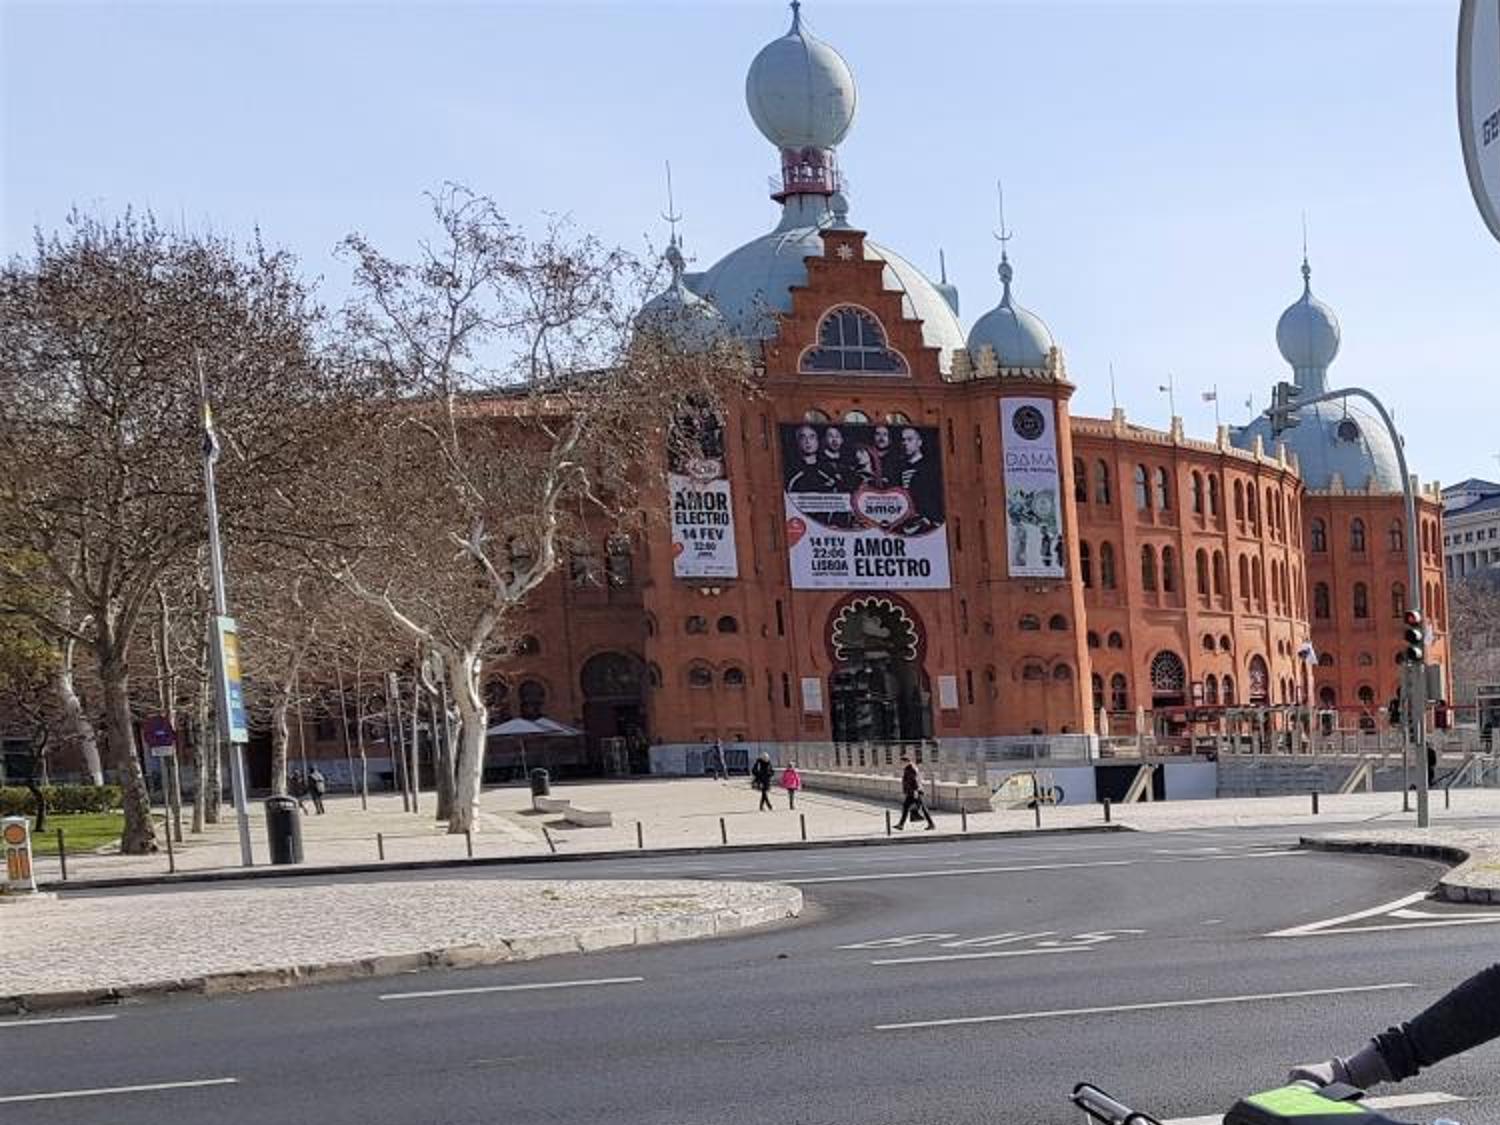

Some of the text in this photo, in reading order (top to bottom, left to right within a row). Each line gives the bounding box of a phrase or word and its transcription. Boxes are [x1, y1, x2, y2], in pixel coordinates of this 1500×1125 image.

[674, 490, 728, 511] AMOR
[865, 504, 902, 515] amor
[675, 511, 729, 526] ELECTRO
[682, 528, 724, 540] 14 FEV
[809, 536, 846, 547] 14 FEV
[853, 538, 906, 557] AMOR
[811, 560, 849, 571] LISBOA
[855, 558, 931, 578] ELECTRO
